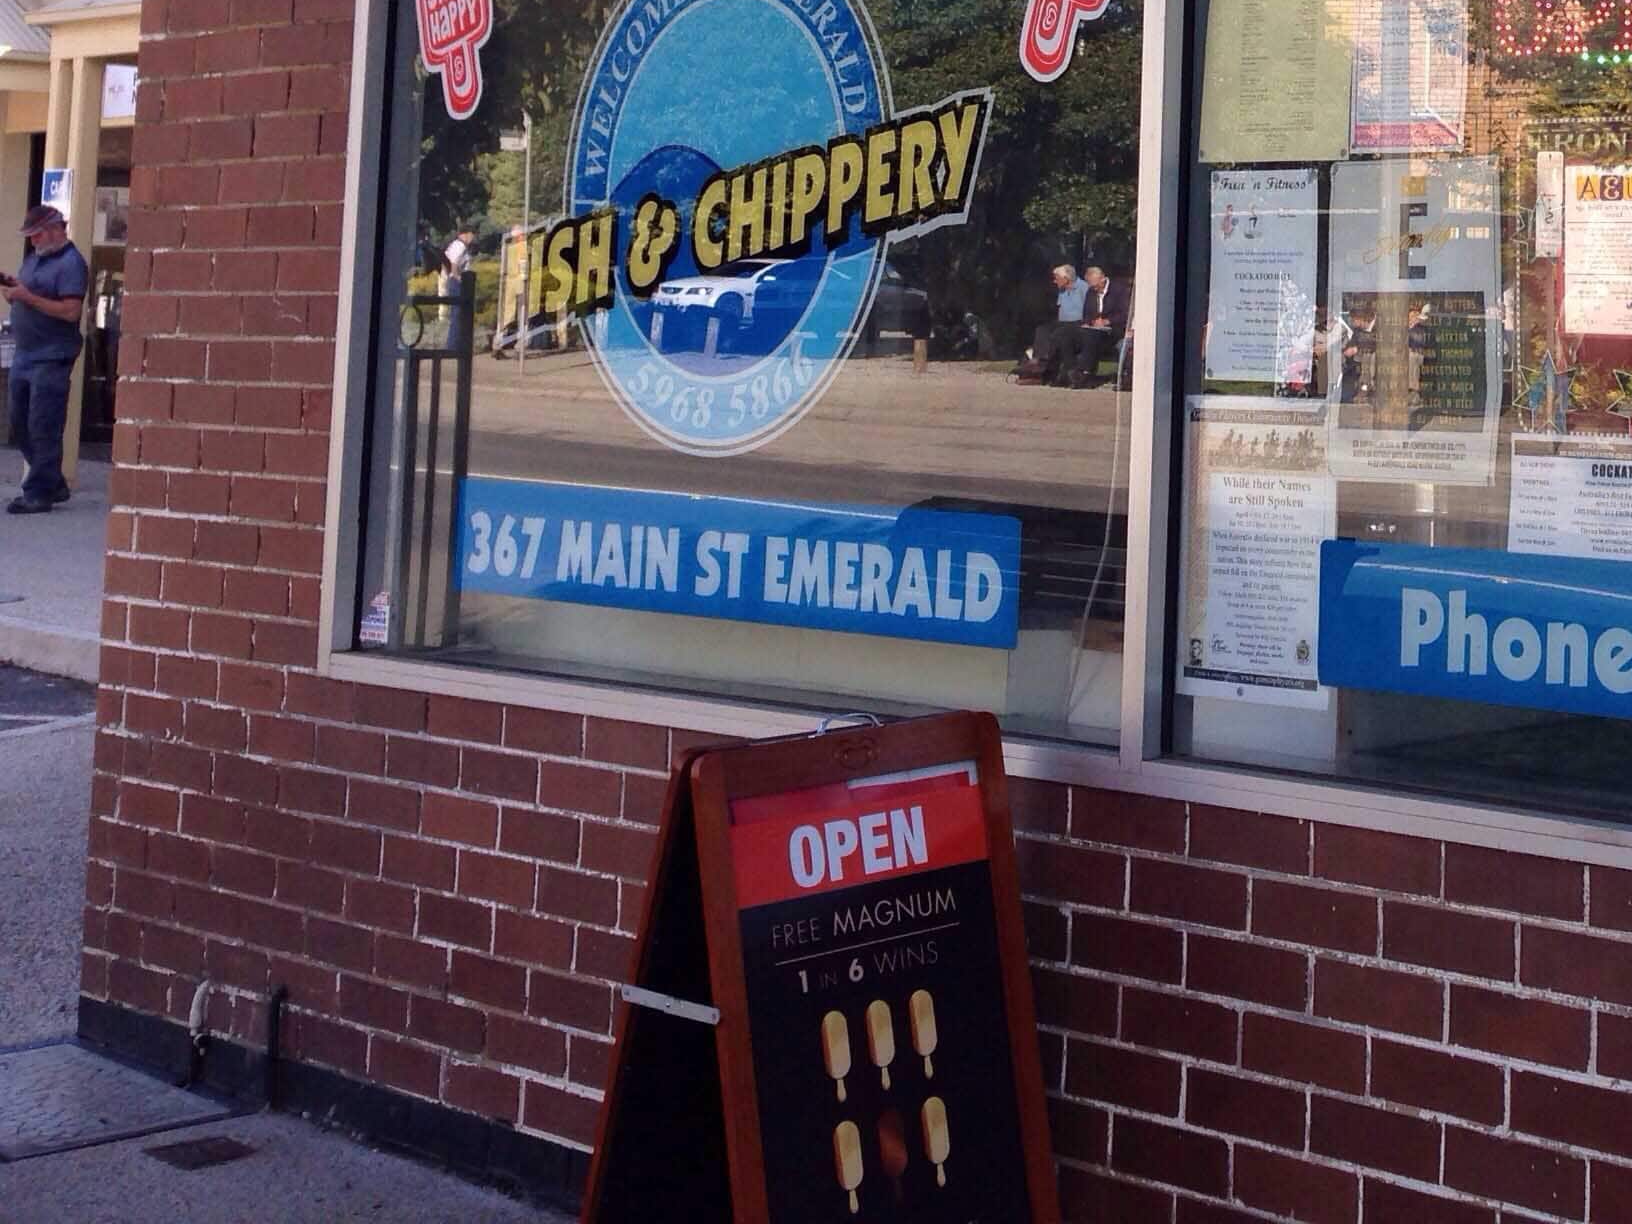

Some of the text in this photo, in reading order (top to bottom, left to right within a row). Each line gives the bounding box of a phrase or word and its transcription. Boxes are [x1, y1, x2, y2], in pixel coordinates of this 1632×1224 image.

[629, 200, 677, 287] &
[694, 104, 978, 267] CHIPPERY
[627, 364, 714, 428] 5968
[1223, 476, 1312, 492] While their Names
[1229, 494, 1304, 510] are Still Spoken
[466, 511, 1002, 623] 367 MAIN ST EMERALD
[788, 805, 928, 889] OPEN
[771, 888, 957, 950] FREE MAGNUM
[798, 941, 939, 994] 1 IN 6 WINS
